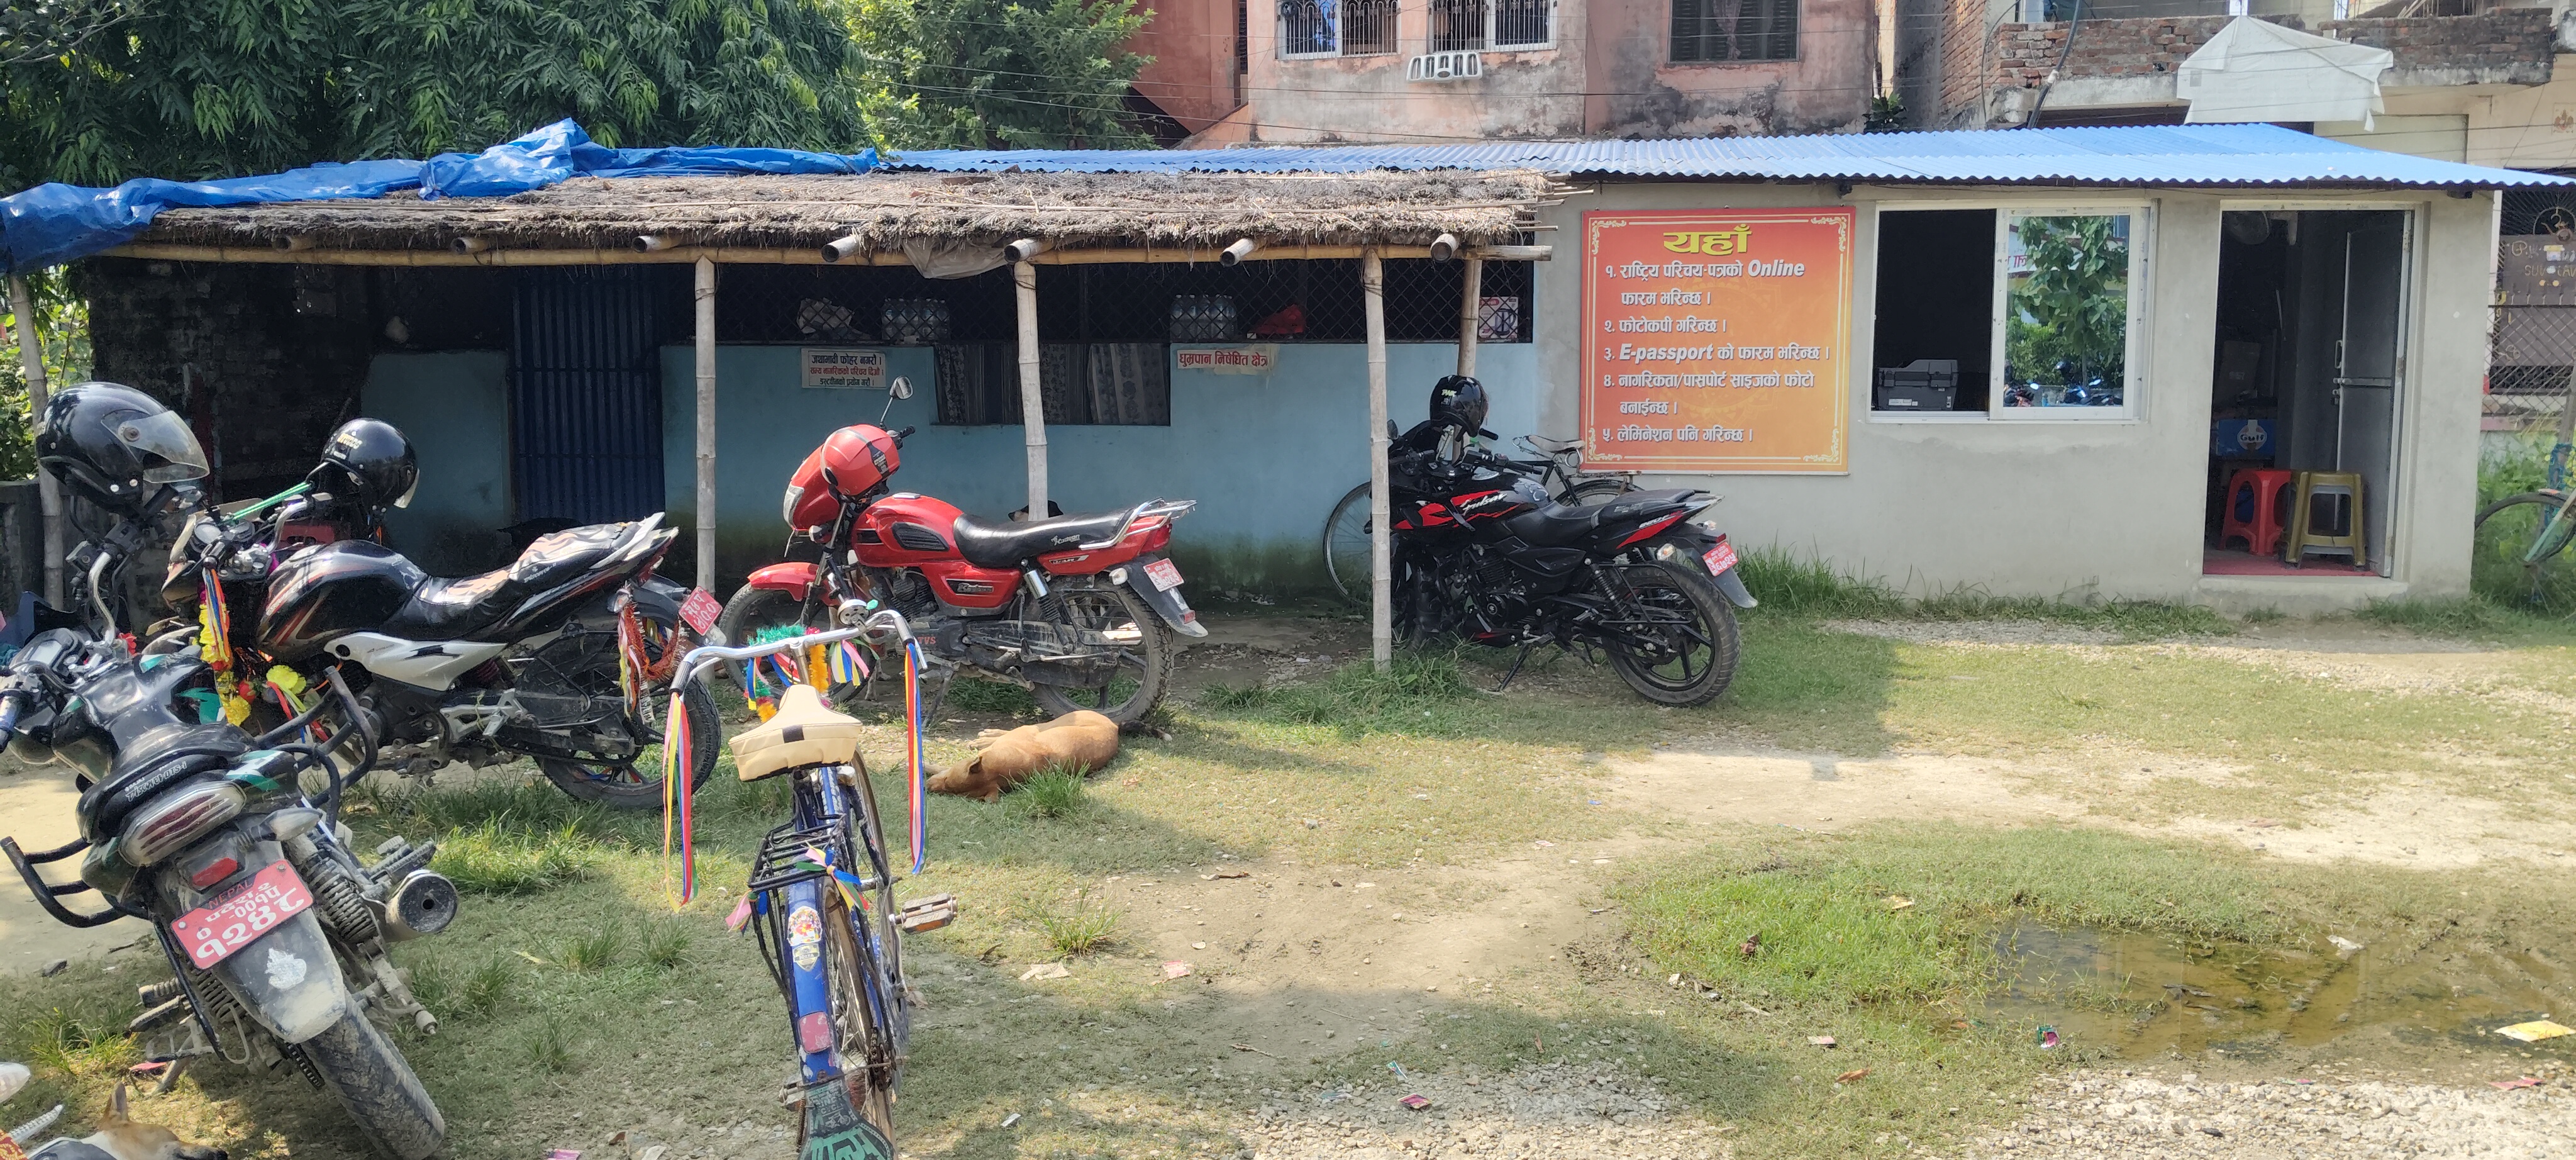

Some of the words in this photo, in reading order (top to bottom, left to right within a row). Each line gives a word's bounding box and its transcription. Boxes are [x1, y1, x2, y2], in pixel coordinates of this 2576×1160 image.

[1663, 223, 1752, 255] यहाँ
[1620, 260, 1660, 281] राष्ट्रिय
[1748, 259, 1805, 277] Online
[1621, 292, 1657, 306] फारम
[1660, 287, 1702, 306] भरिन्छ
[1619, 316, 1673, 333] फोटोकपी
[1676, 315, 1718, 333] गरिन्छ
[1251, 352, 1268, 367] क्षेत्र
[1619, 343, 1714, 364] E-passport
[1718, 343, 1735, 360] को
[1738, 347, 1774, 360] फारम
[1778, 342, 1821, 360] भरिन्छ
[1730, 370, 1781, 389] साइजको
[1784, 370, 1814, 387] फोटो
[1620, 398, 1668, 416] बनाईन्छ
[1618, 425, 1673, 442] लेमिनेशन
[1677, 424, 1699, 441] पनि
[1702, 424, 1744, 442] गरिन्छ
[918, 636, 936, 645] TVS
[208, 879, 253, 910] NEPAL
[196, 887, 304, 958] १२४८
